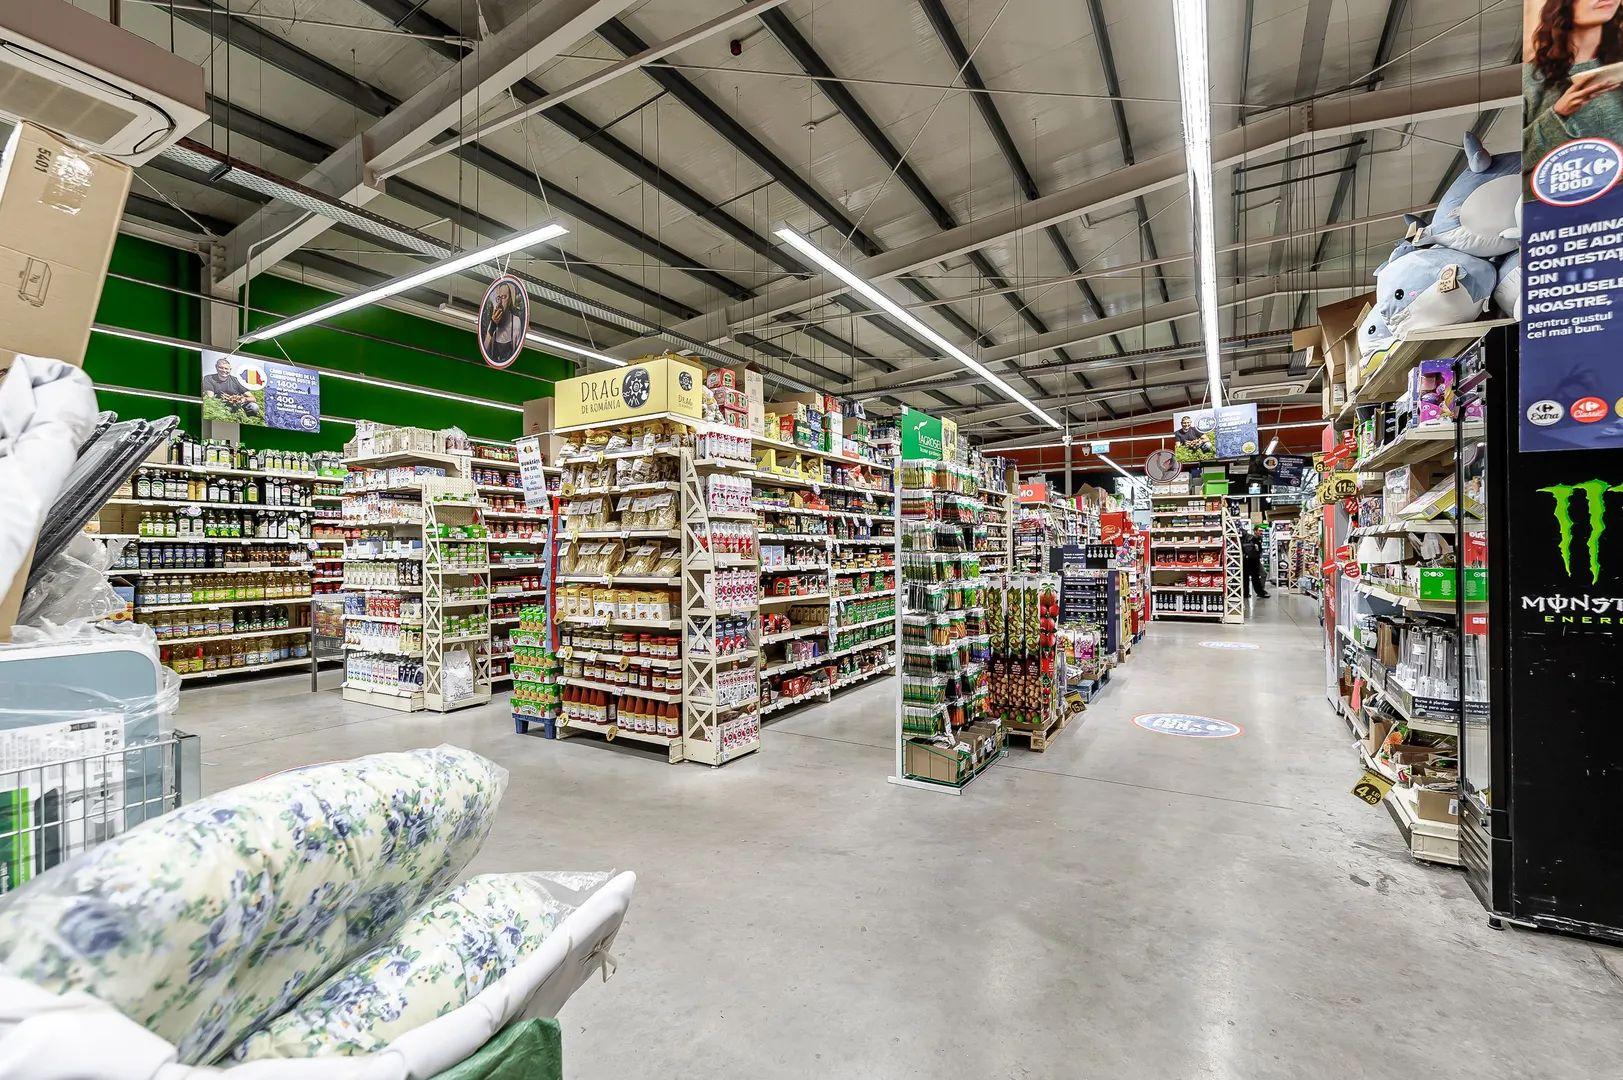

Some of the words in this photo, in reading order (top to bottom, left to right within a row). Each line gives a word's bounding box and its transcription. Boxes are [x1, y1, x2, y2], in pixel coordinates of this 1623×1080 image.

[34, 147, 52, 173] 5401
[1552, 157, 1584, 174] ACT
[1551, 169, 1580, 184] FOR
[1550, 176, 1593, 193] FOOD
[1528, 229, 1557, 244] AM
[1528, 244, 1558, 258] 100
[1564, 238, 1588, 252] DE
[1590, 233, 1623, 248] ADI
[1528, 272, 1559, 287] DIN
[1527, 317, 1569, 331] pentru
[1571, 311, 1613, 326] gustul
[1527, 329, 1546, 340] cel
[1548, 326, 1572, 337] mai
[1574, 324, 1605, 334] bun.
[277, 380, 298, 389] 1400
[581, 377, 620, 403] DRAG
[277, 396, 295, 404] 400
[581, 404, 589, 414] DE
[1336, 482, 1347, 492] 11
[1356, 786, 1370, 797] 4
